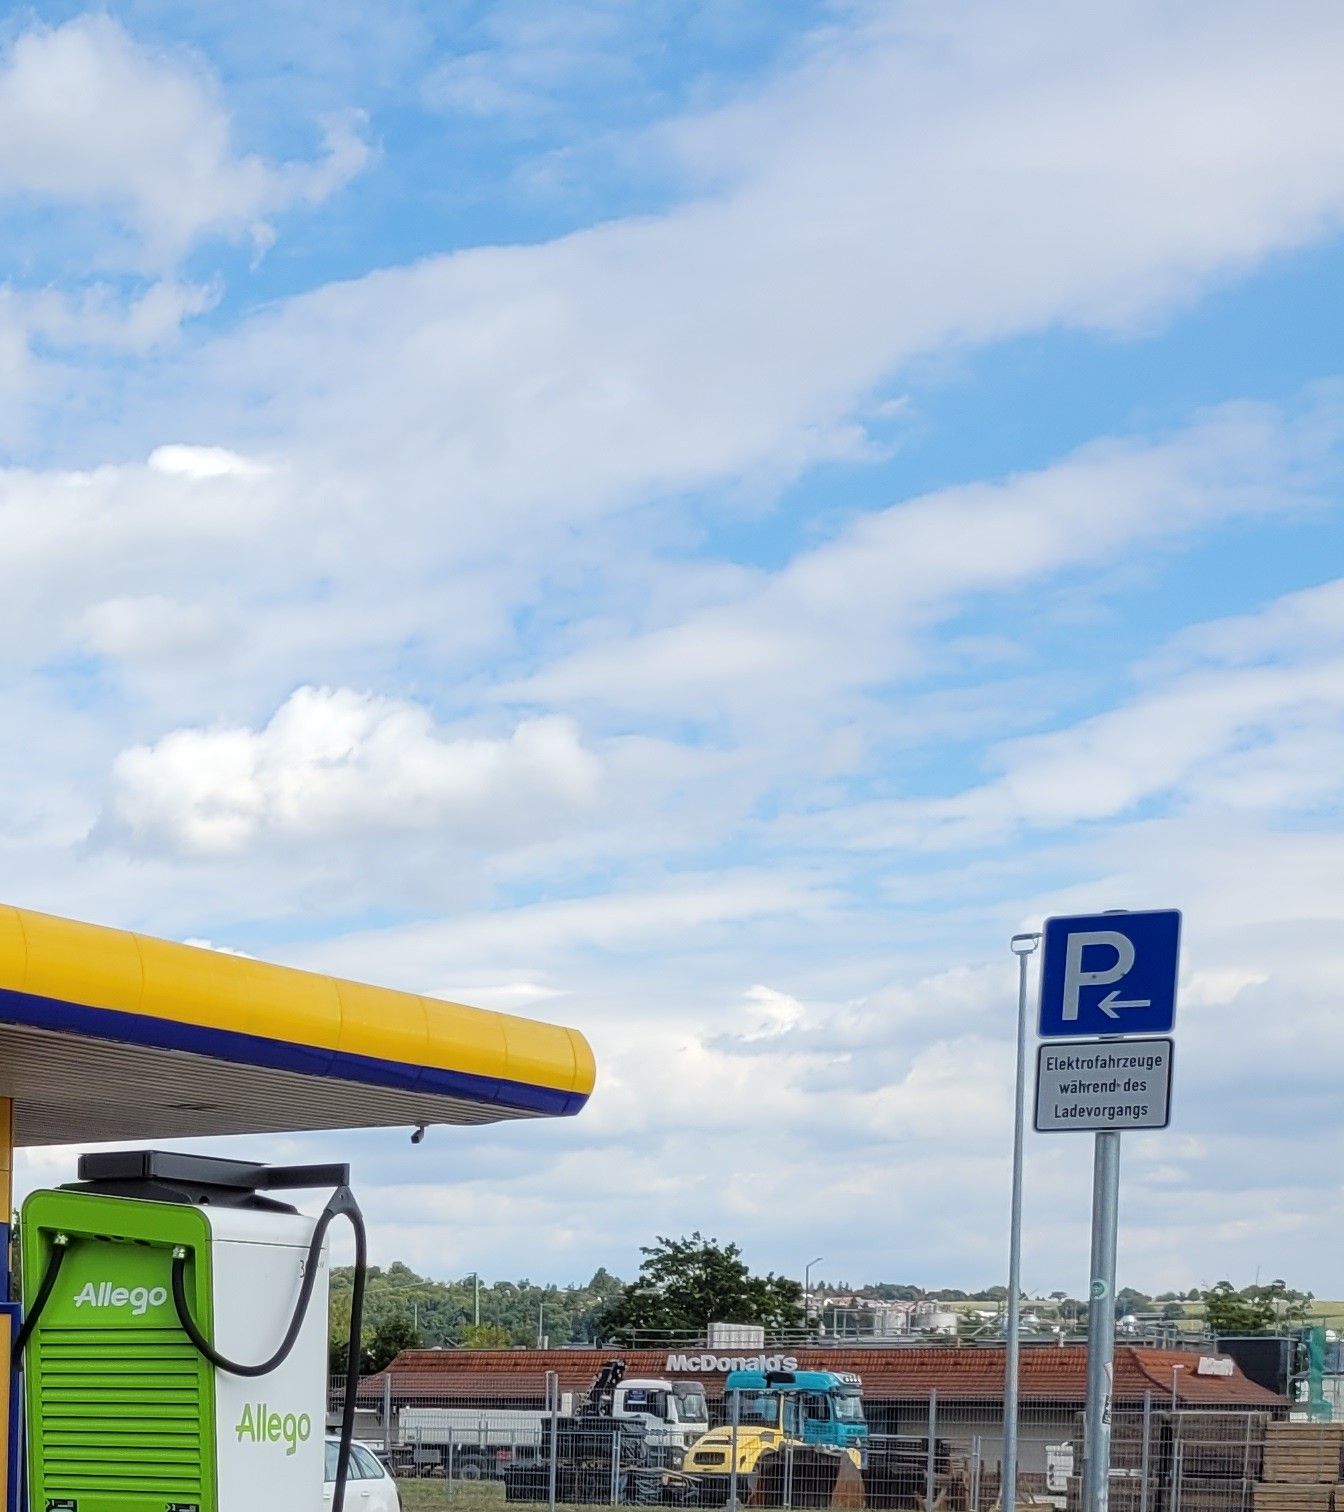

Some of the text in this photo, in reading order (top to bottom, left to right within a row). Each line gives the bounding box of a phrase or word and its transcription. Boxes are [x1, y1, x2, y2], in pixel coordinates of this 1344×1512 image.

[1062, 931, 1135, 1020] P
[1046, 1055, 1162, 1072] Elektrofahrzeuge
[1059, 1078, 1147, 1094] während des
[1054, 1103, 1149, 1120] Ladevorgangs
[73, 1282, 168, 1316] Allego
[665, 1354, 798, 1373] McDonald's
[235, 1403, 311, 1456] Allego
